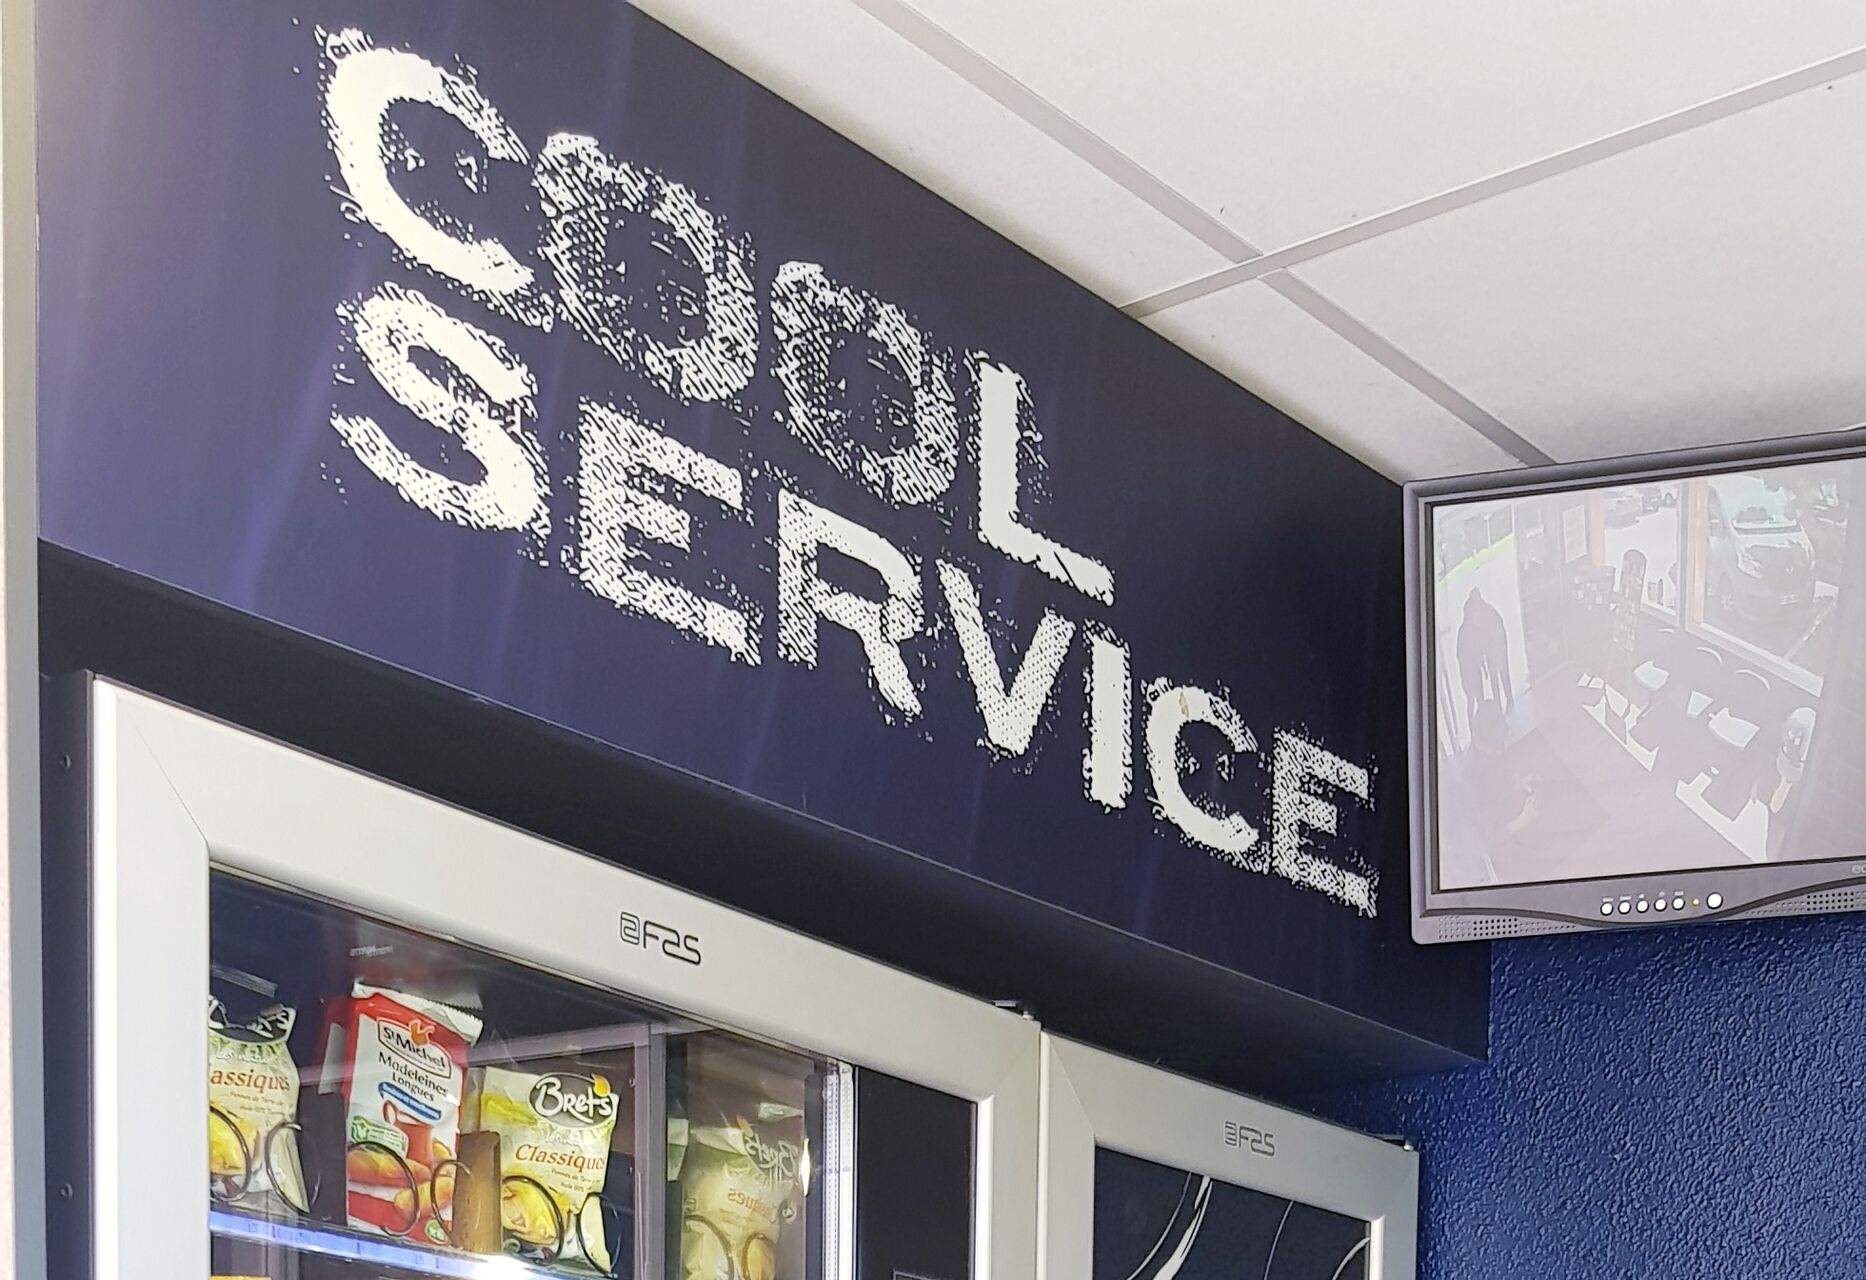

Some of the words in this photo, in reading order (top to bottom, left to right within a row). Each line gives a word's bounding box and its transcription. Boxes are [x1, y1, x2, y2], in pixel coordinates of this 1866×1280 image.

[318, 28, 1114, 605] COOL
[330, 283, 1378, 918] SERVICE
[377, 1051, 449, 1096] Madeleines
[391, 1071, 435, 1103] Longues
